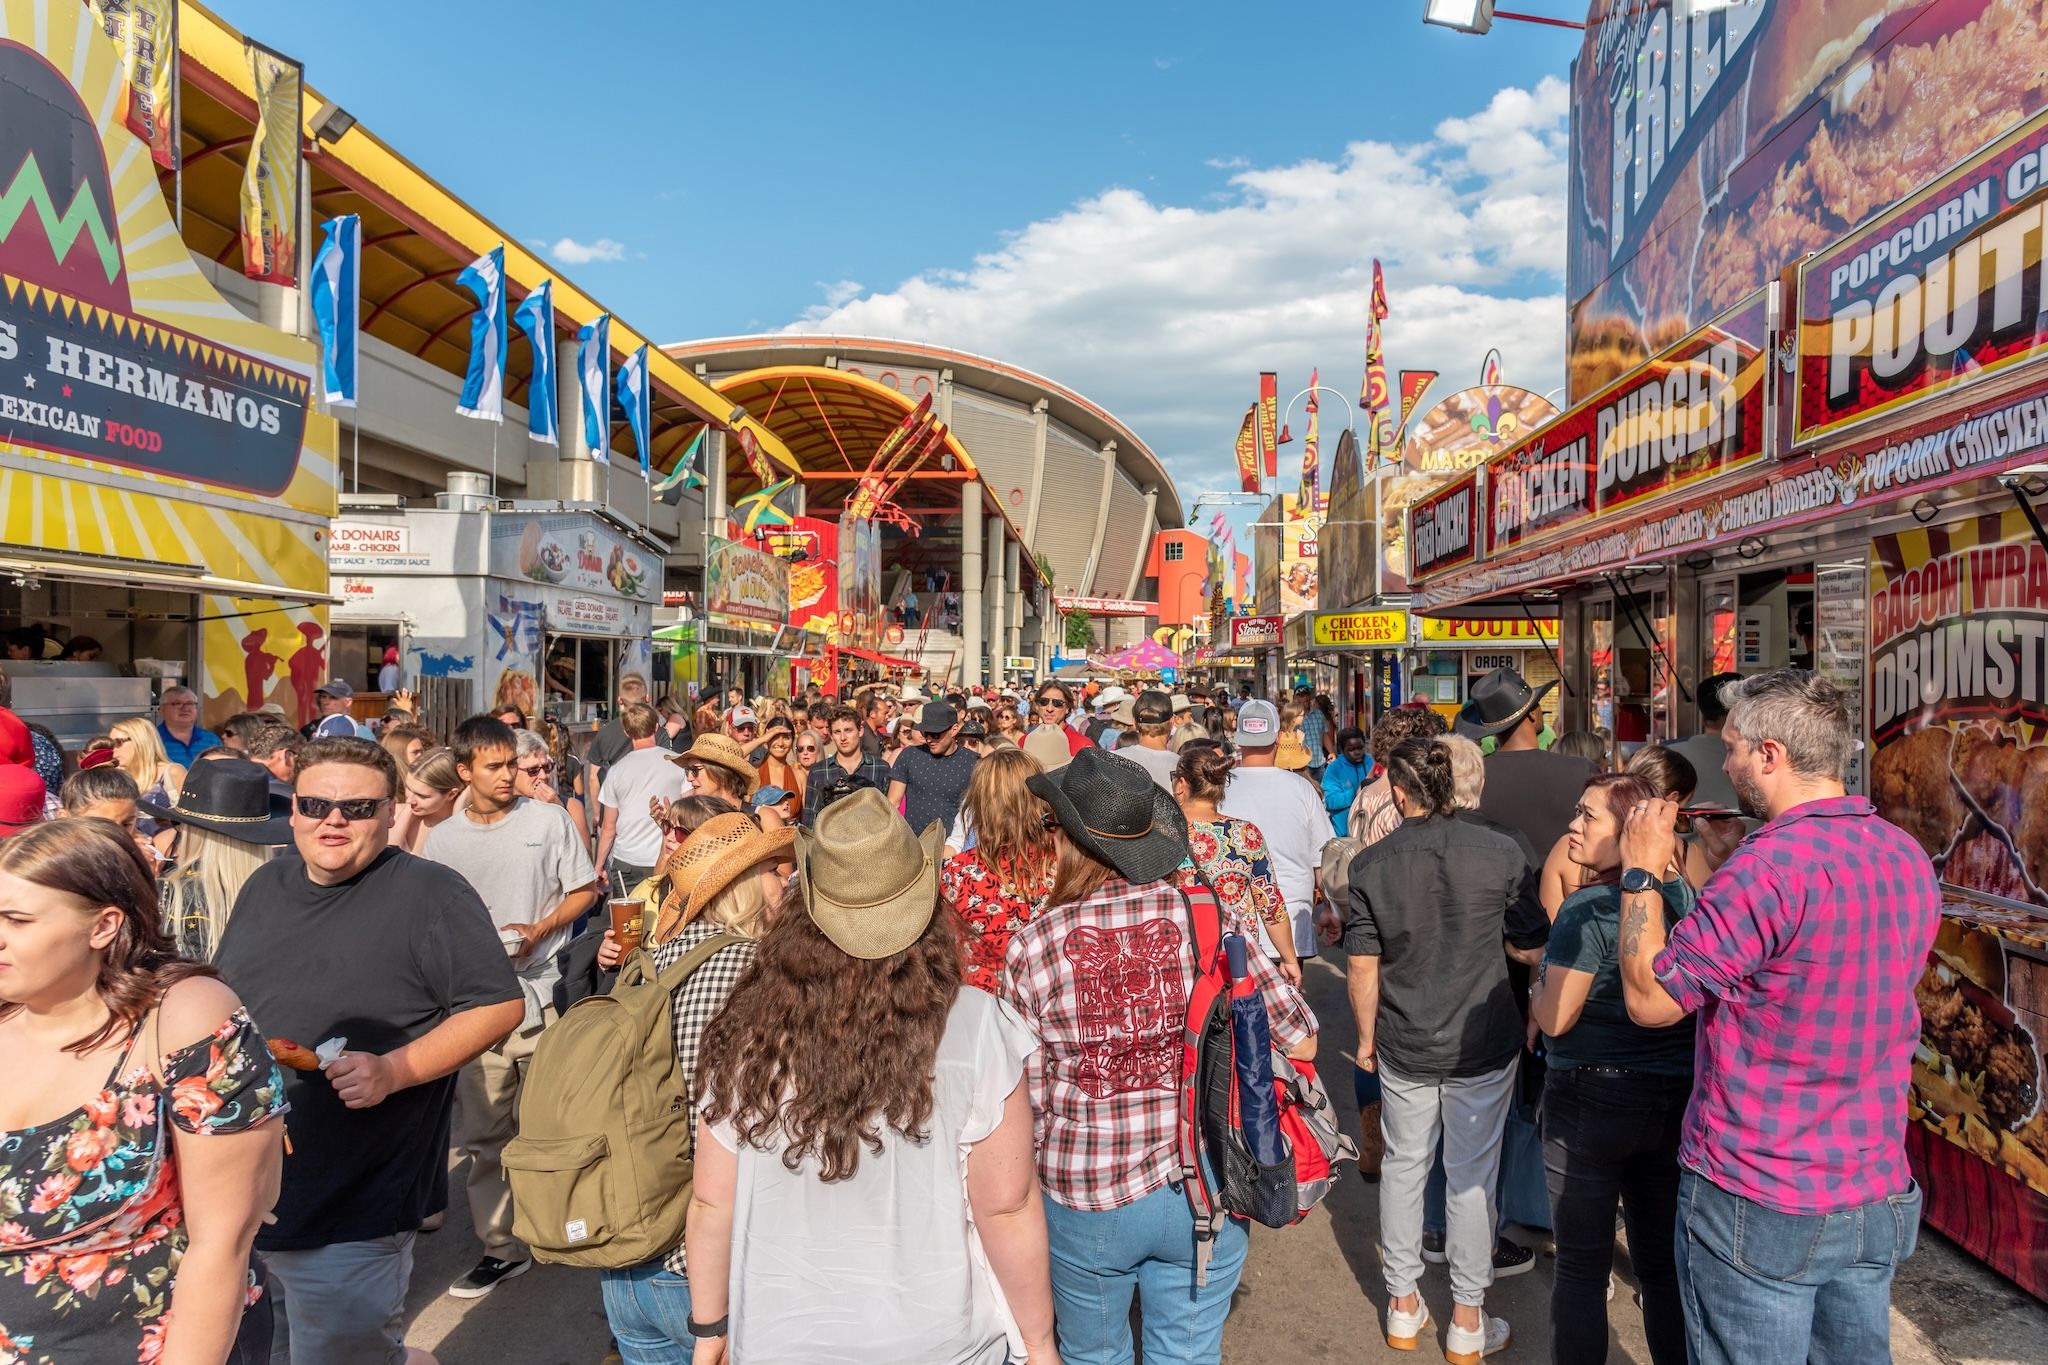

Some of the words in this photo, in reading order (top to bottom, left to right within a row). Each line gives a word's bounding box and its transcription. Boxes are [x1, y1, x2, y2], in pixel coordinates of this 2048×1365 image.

[1830, 179, 1989, 300] POPCORN
[46, 335, 281, 435] HERMANOS
[1260, 403, 1271, 428] FRIED
[1597, 339, 1738, 491] BURGER
[105, 420, 162, 452] FOOD
[1263, 430, 1275, 451] DEEP
[1863, 430, 1951, 493] POPCORN
[1949, 396, 2048, 468] CHICKEN
[1494, 436, 1587, 534] CHICKEN
[1722, 490, 1771, 532] CHICKEN
[1773, 466, 1836, 516] BURGERS
[342, 530, 401, 541] DONAIRS
[1415, 520, 1434, 567] FRIED
[1434, 488, 1469, 558] CHICKEN
[1638, 520, 1662, 554] FRIED
[1663, 509, 1703, 548] CHICKEN
[359, 544, 400, 552] CHICKEN
[1873, 555, 1961, 650] BACON
[1238, 621, 1279, 636] Steve-O's
[1329, 627, 1391, 641] TENDERS
[1330, 616, 1389, 629] CHICKEN
[1449, 620, 1558, 636] POUTIN
[1200, 657, 1227, 665] DRINKS
[1475, 655, 1514, 669] ORDER
[1875, 619, 2048, 730] DRUMST
[1383, 686, 1391, 708] GRAS
